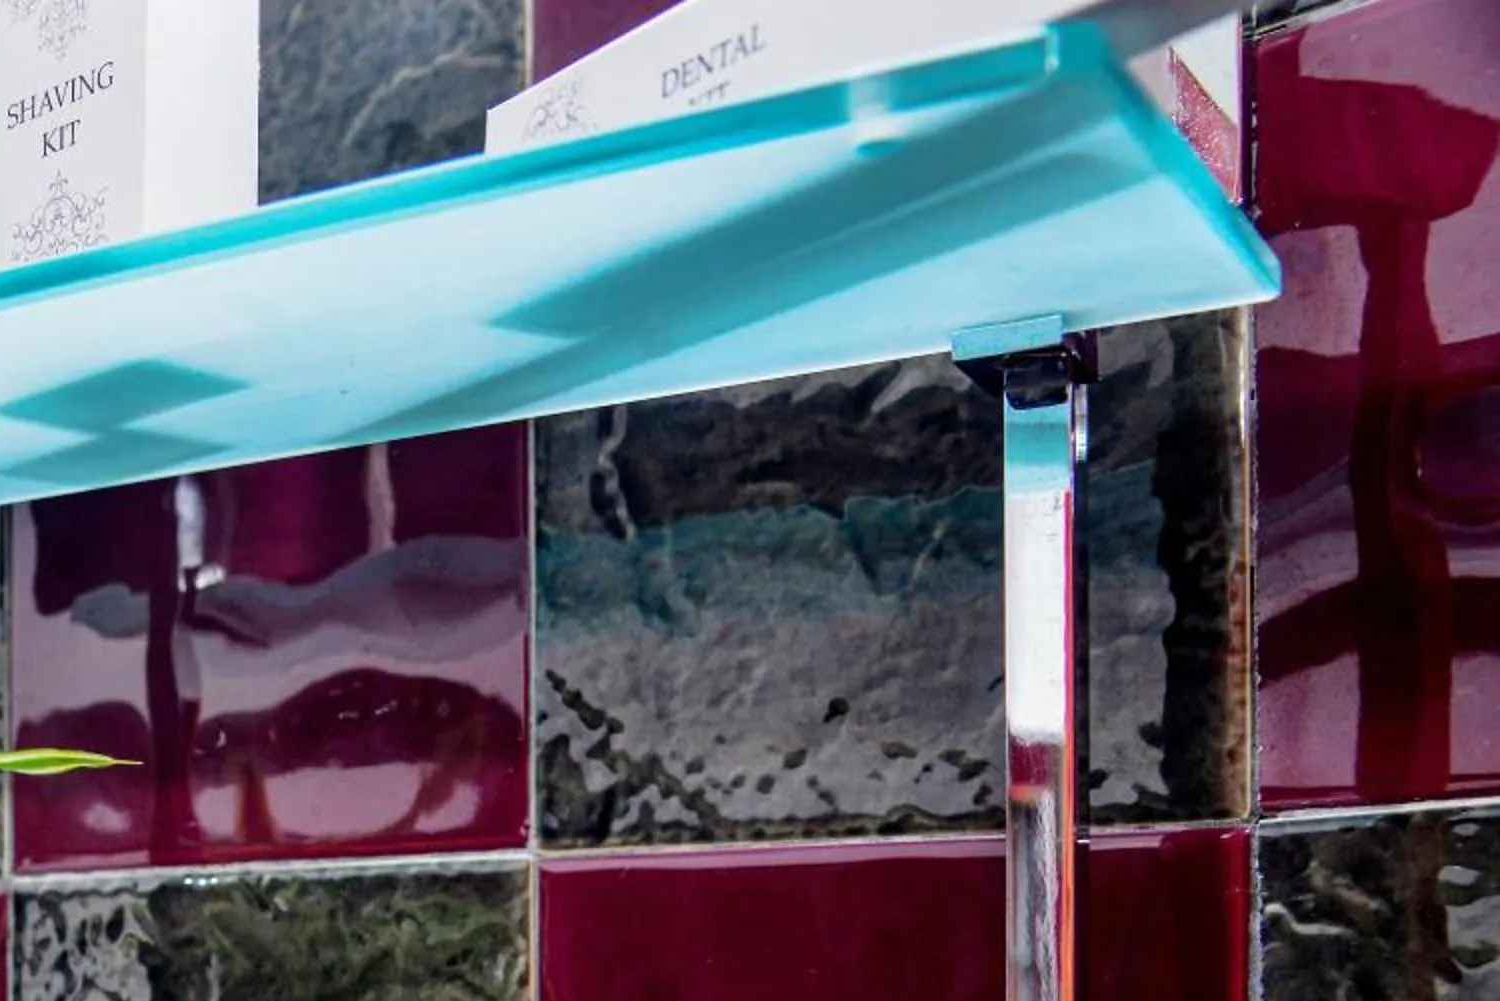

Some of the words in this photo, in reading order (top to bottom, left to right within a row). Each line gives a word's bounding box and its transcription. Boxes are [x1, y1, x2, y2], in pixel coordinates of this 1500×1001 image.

[6, 60, 115, 130] SHAVING
[661, 23, 769, 98] DENTAL
[41, 118, 81, 159] KIT
